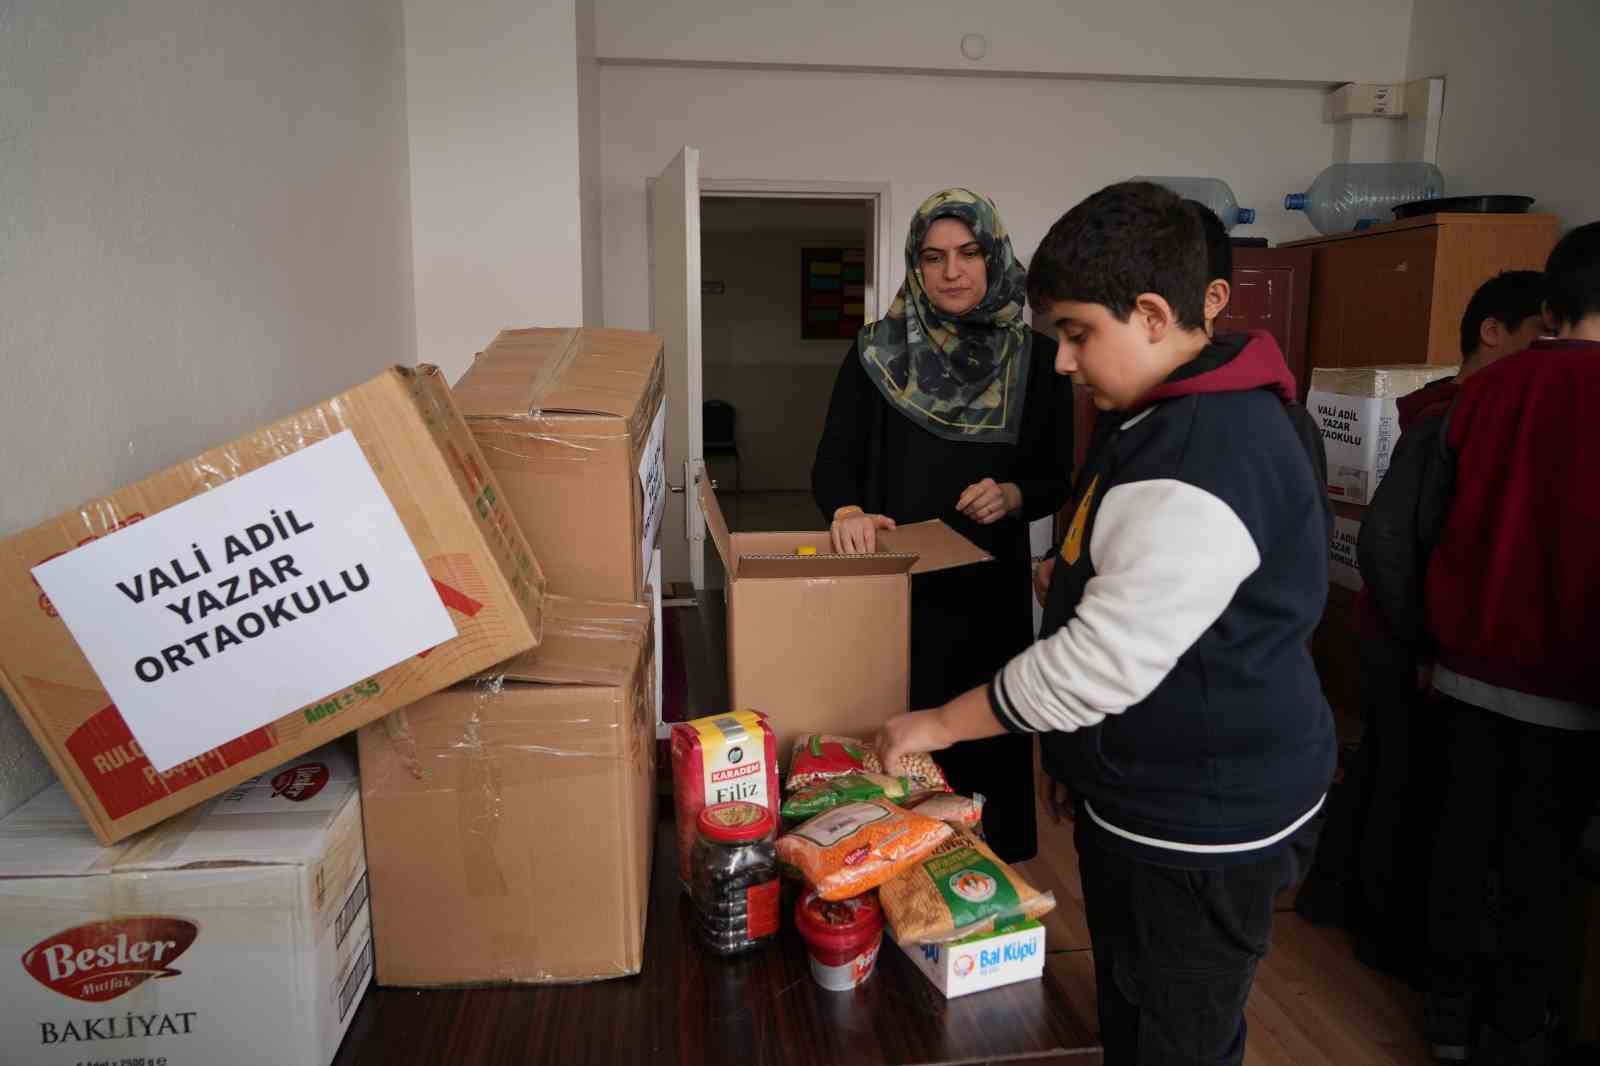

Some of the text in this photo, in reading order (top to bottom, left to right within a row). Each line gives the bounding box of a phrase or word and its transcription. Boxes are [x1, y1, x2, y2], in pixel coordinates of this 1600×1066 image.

[1320, 429, 1362, 446] TAOKULU
[1322, 417, 1350, 432] YAZAR
[115, 542, 212, 604] VALİ
[224, 509, 314, 564] ADİL
[166, 554, 303, 625] YAZAR
[134, 563, 370, 683] ORTAOKULU
[717, 782, 759, 802] Filiz
[42, 934, 175, 982] Besler
[980, 938, 1037, 969] Bal Küpü
[80, 976, 133, 998] Mutfak
[40, 1011, 198, 1045] BAKLİYAT
